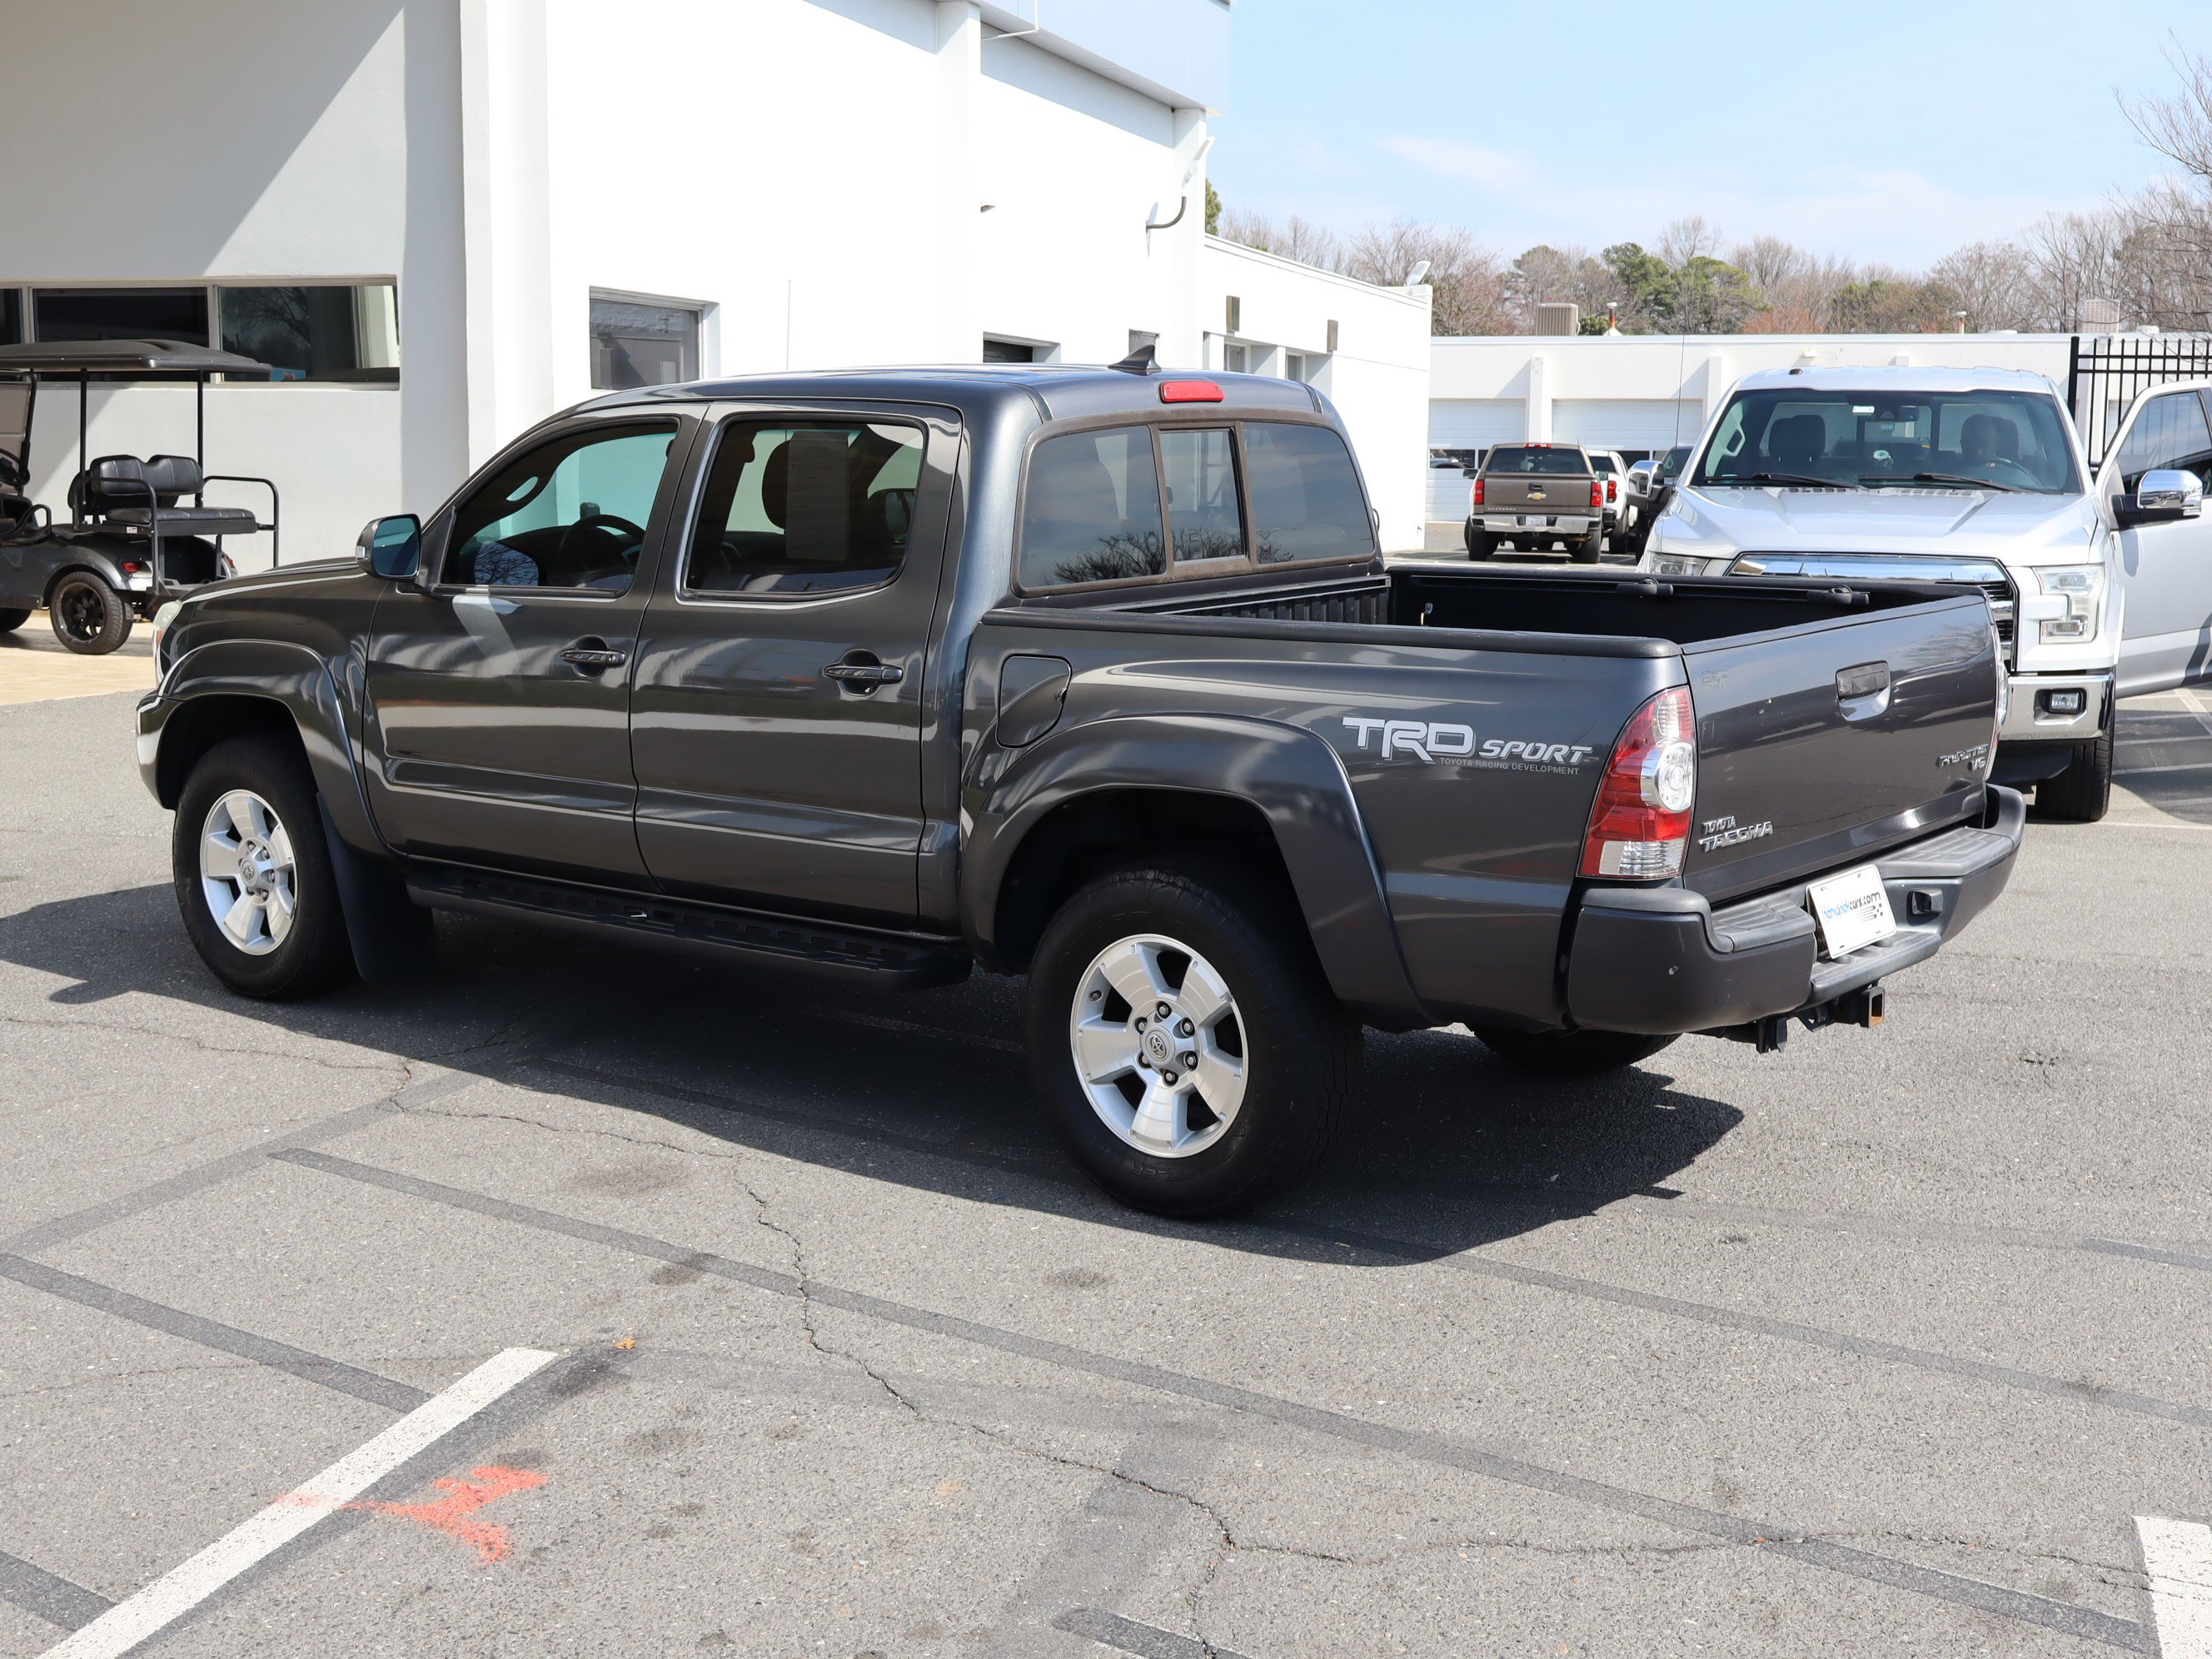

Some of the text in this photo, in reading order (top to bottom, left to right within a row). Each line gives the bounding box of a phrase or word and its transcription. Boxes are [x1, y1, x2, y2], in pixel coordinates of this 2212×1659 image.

[1343, 716, 1592, 765] TRD SPORT
[1440, 757, 1580, 775] TOYOTA RACING DEVELOPMENT
[1698, 820, 1774, 852] TACOMA
[1701, 815, 1736, 834] TOYOTA
